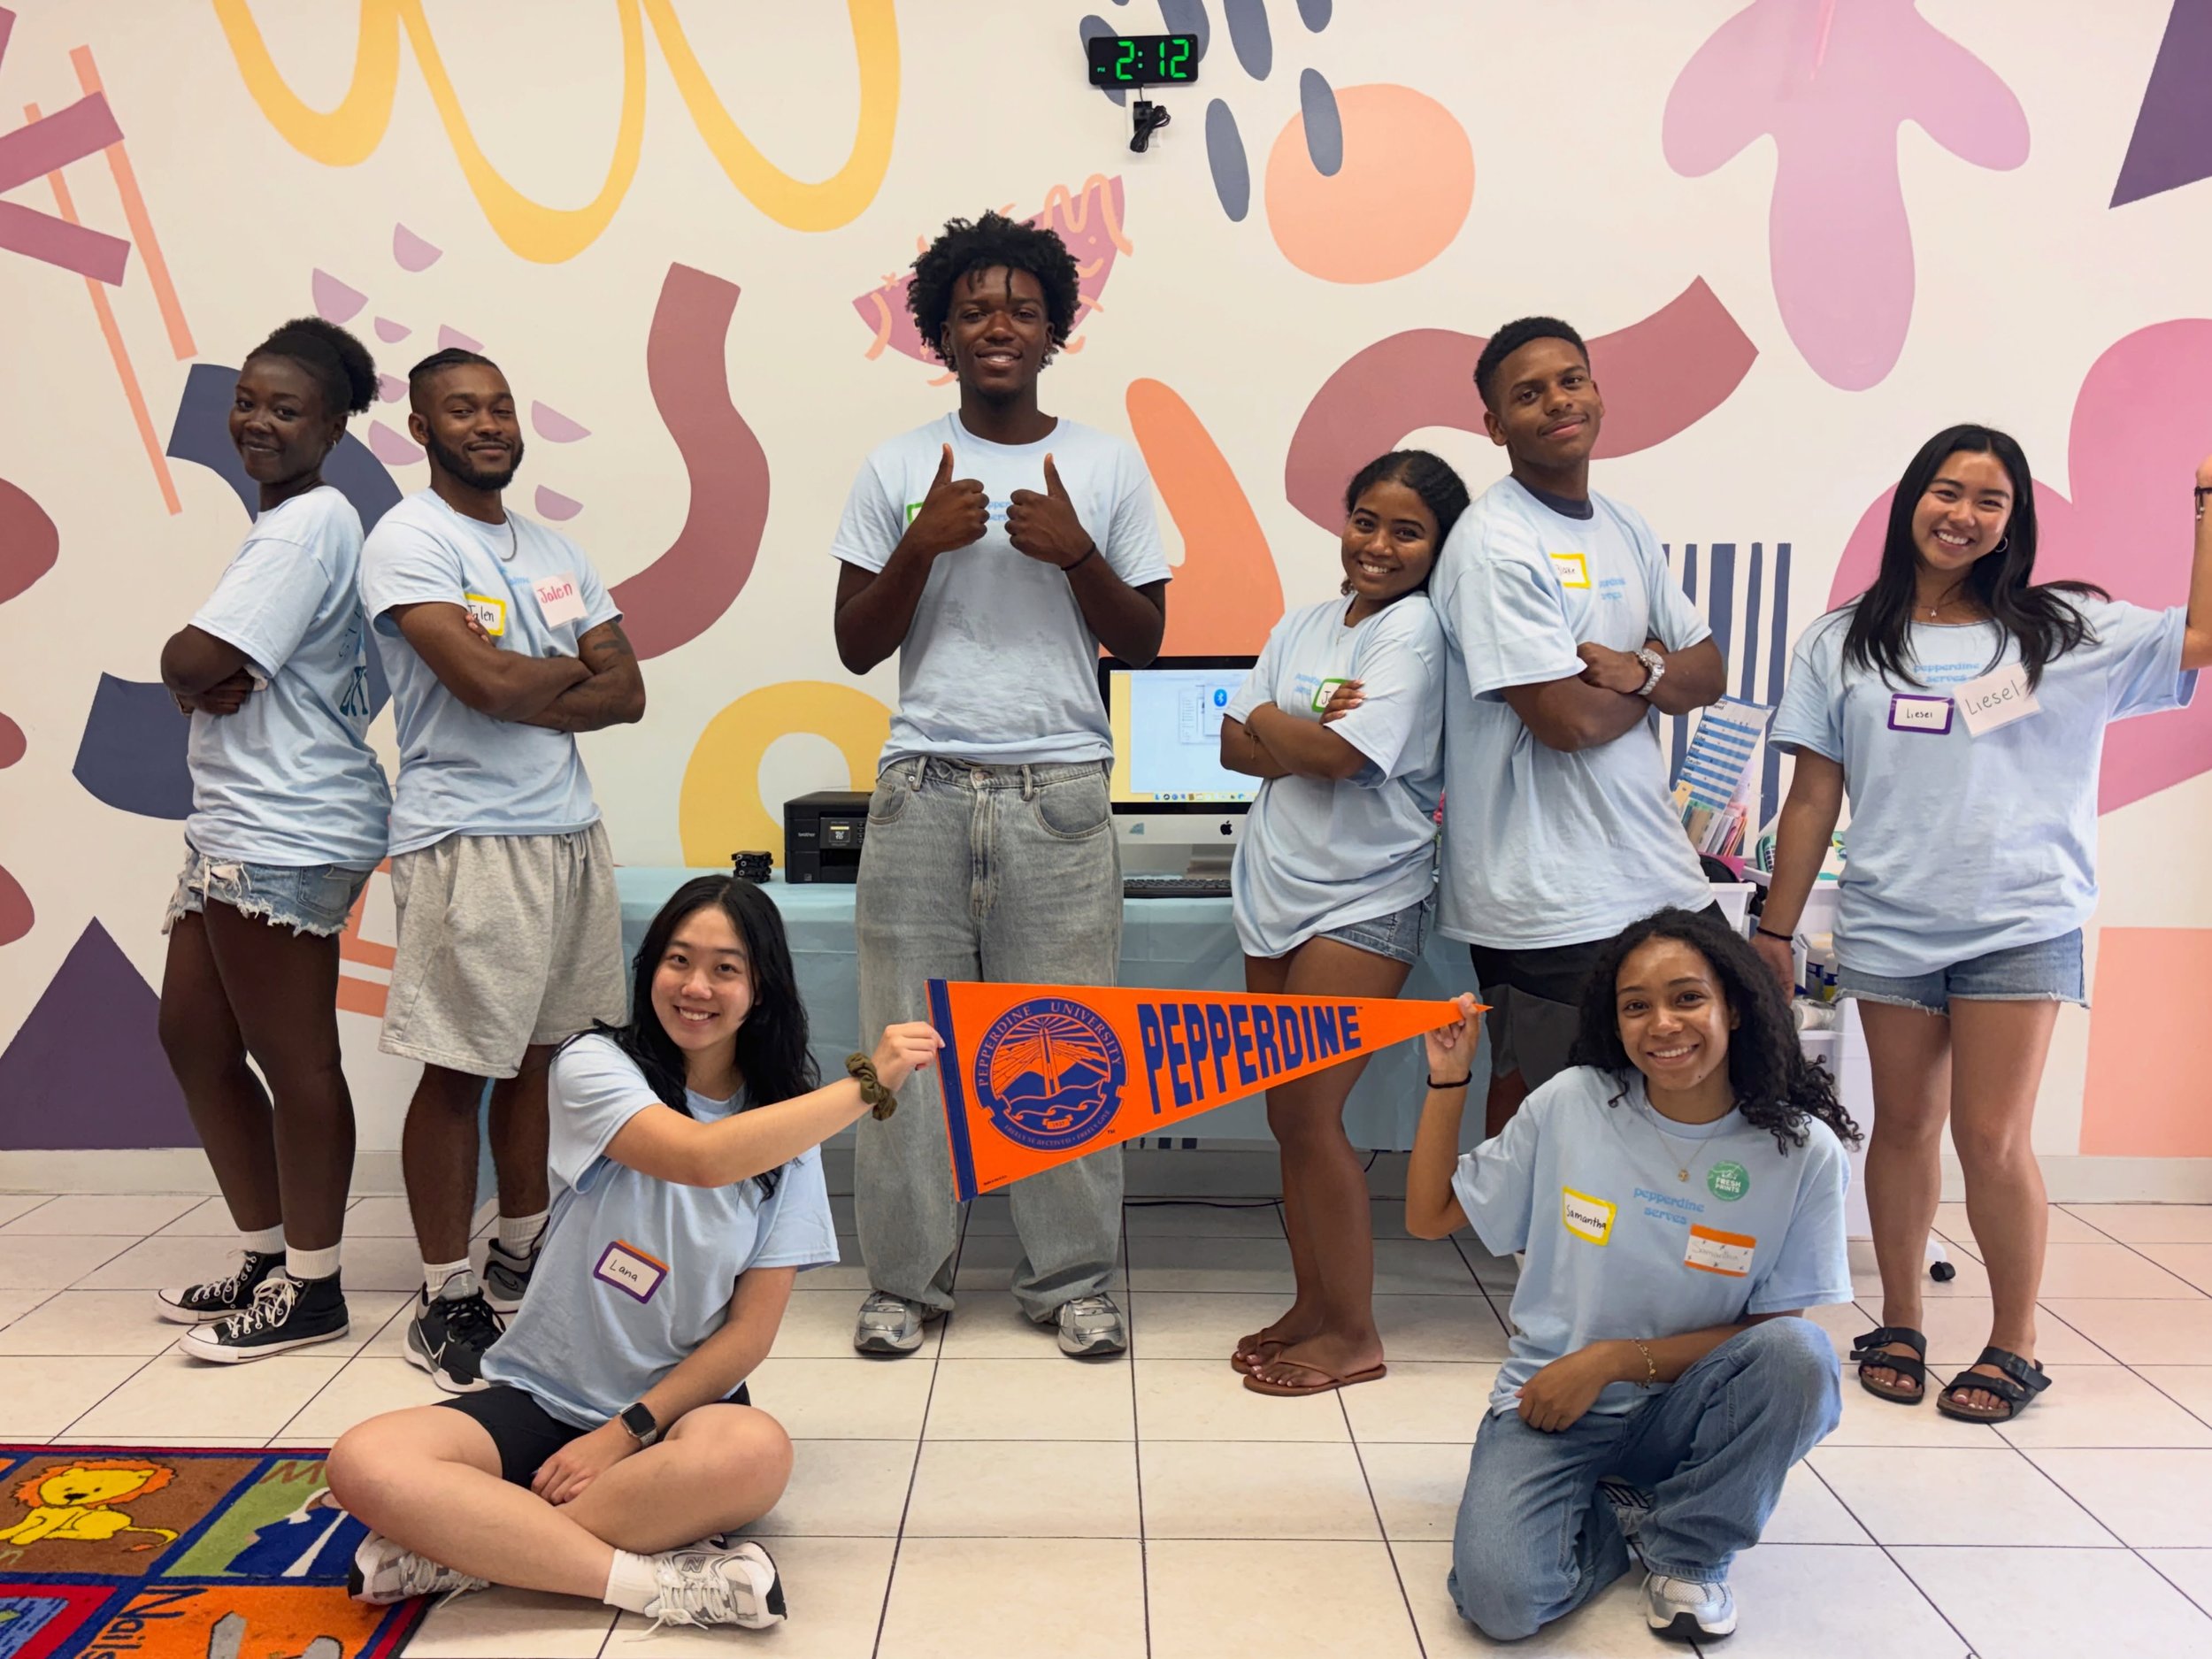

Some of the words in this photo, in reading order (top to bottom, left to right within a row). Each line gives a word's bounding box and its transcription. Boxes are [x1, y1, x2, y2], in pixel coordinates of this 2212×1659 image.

[1116, 38, 1189, 80] 2:12
[536, 583, 573, 603] Jalen
[1914, 662, 1980, 673] pepperdine
[1925, 675, 1968, 684] serves
[1964, 680, 2021, 716] Liesel
[979, 1005, 1033, 1087] PEPPERDINE
[1050, 1002, 1122, 1065] UNIVERSITY
[1137, 1003, 1362, 1115] PEPPERDINE
[1715, 1183, 1740, 1194] PRINTS
[1716, 1176, 1741, 1188] FRESH
[1633, 1187, 1706, 1213] pepperdine
[1565, 1204, 1608, 1232] Samantha
[1643, 1206, 1687, 1225] serves
[609, 1259, 638, 1282] Lana
